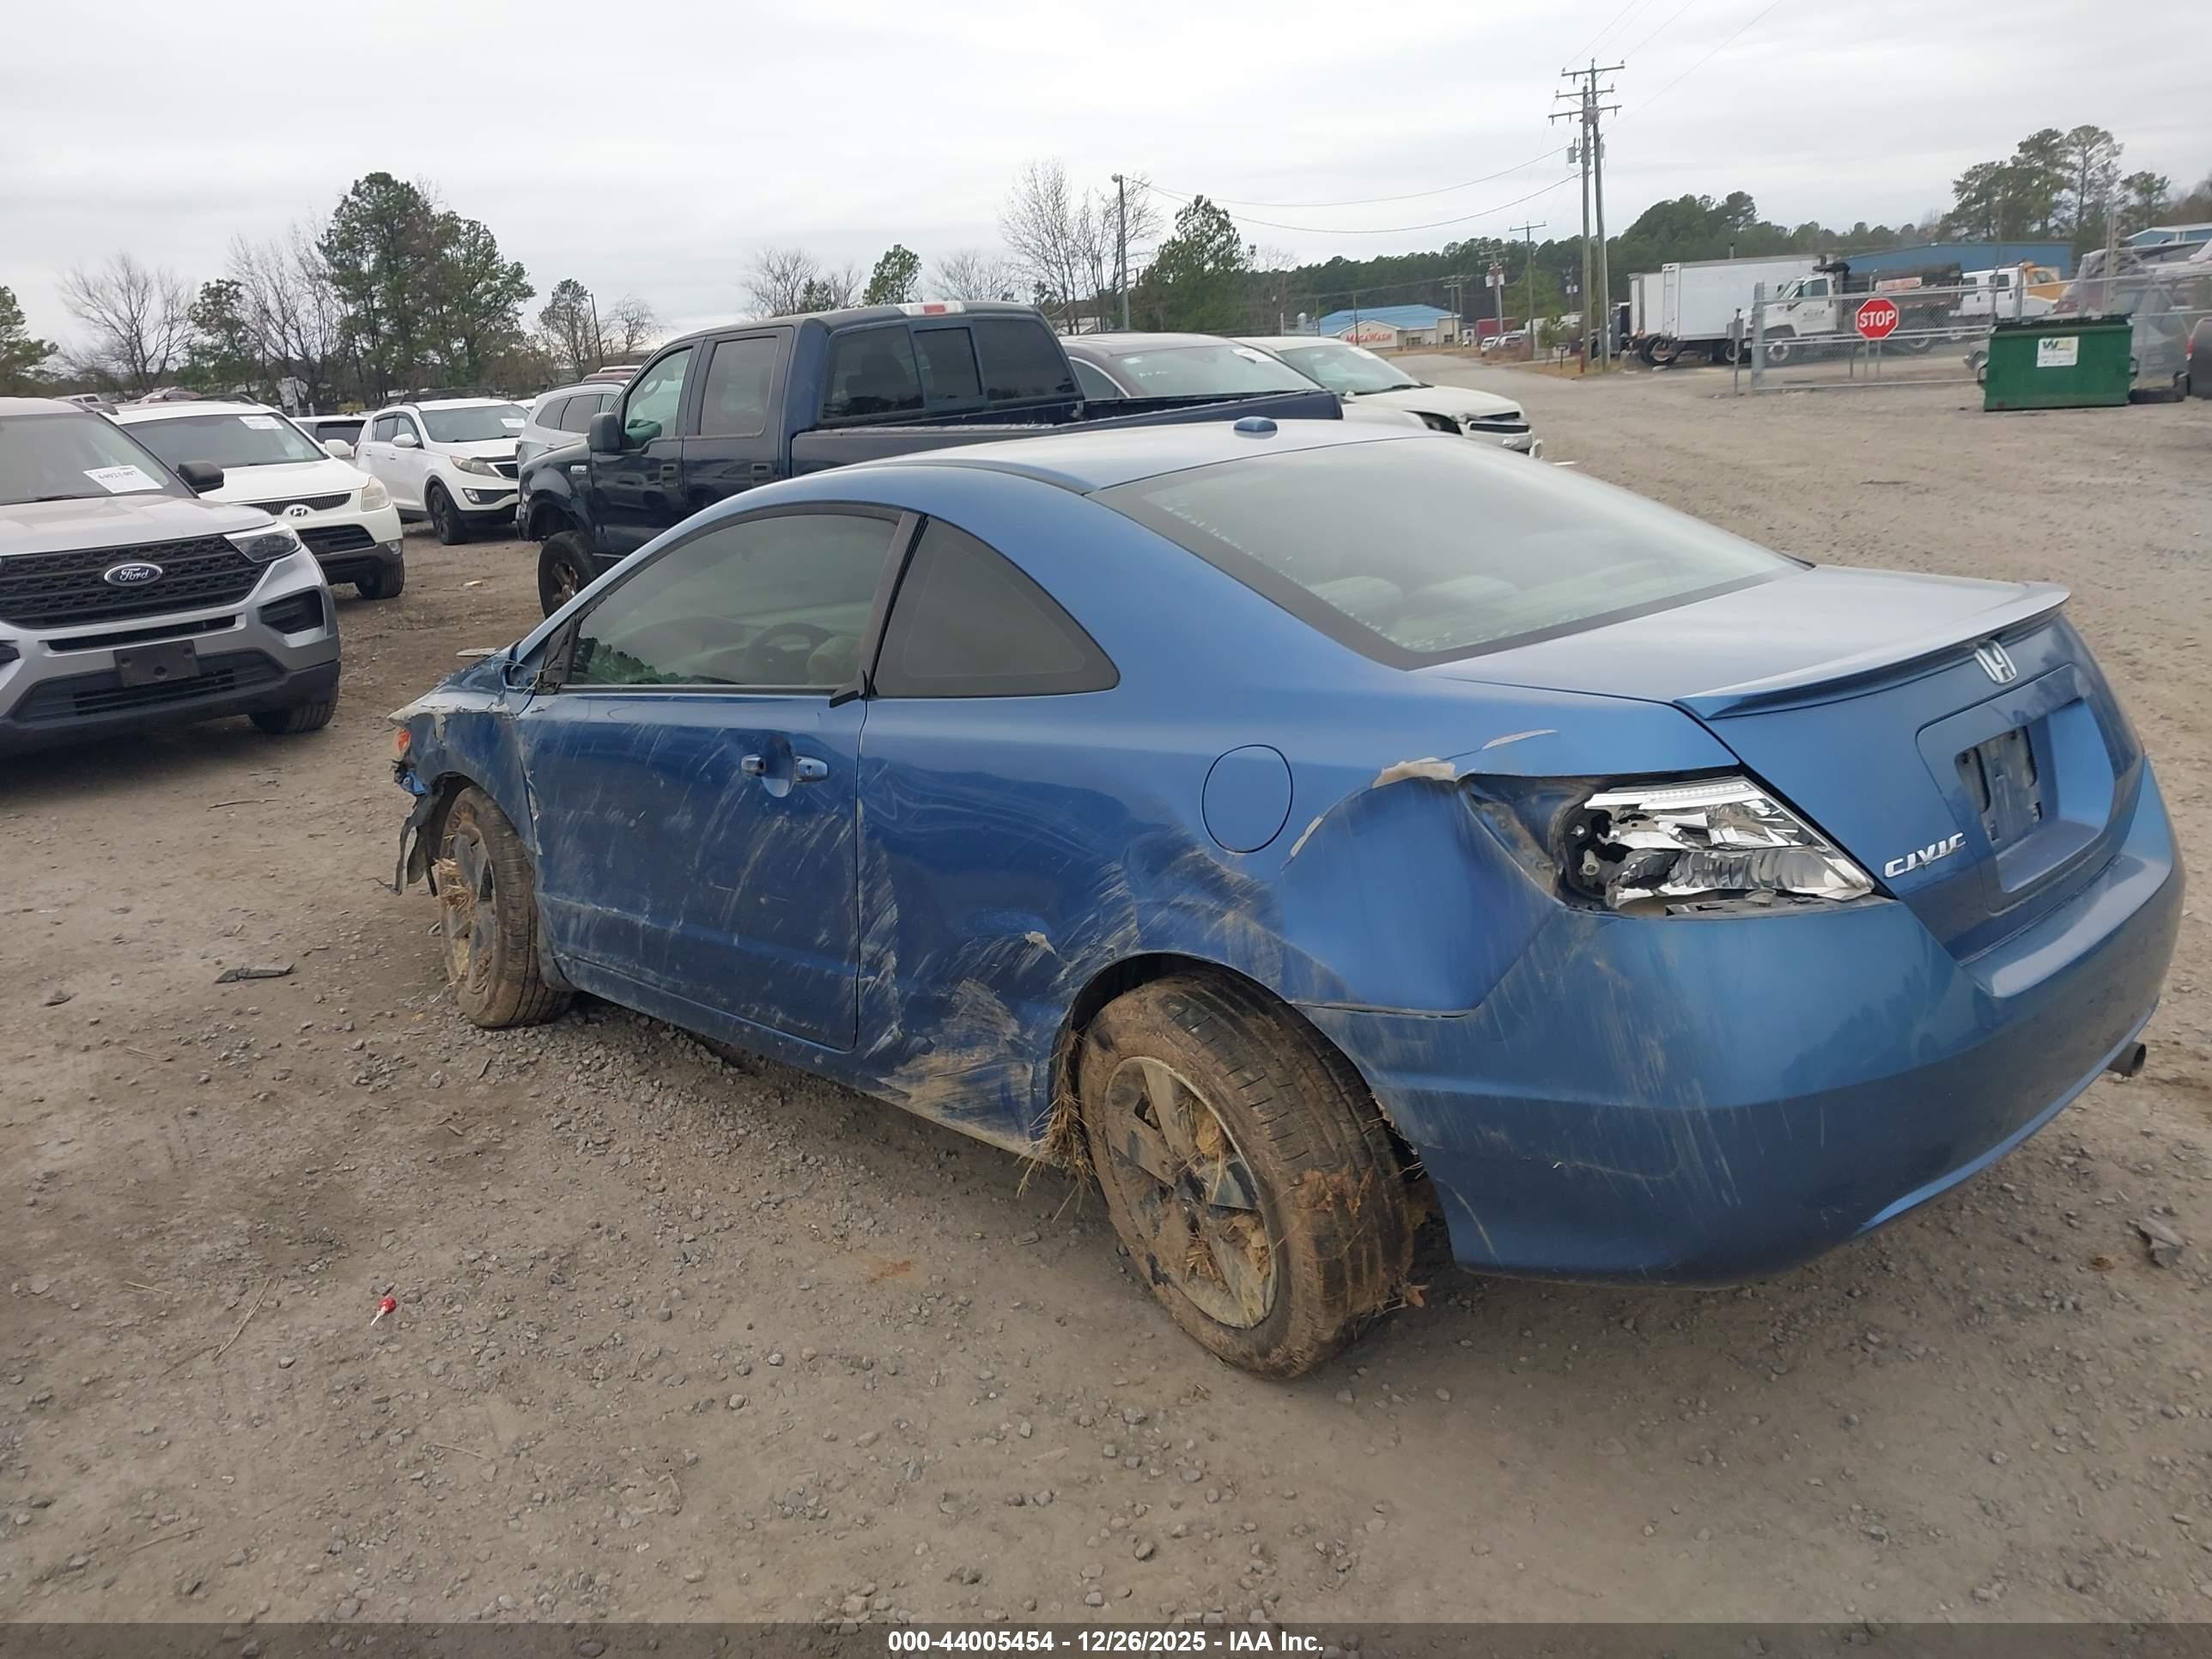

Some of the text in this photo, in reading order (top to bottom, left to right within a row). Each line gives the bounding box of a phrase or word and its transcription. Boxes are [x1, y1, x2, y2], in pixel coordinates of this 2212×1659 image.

[1859, 310, 1896, 328] STOP
[119, 568, 150, 581] Ford
[1885, 832, 1967, 878] CIVIC
